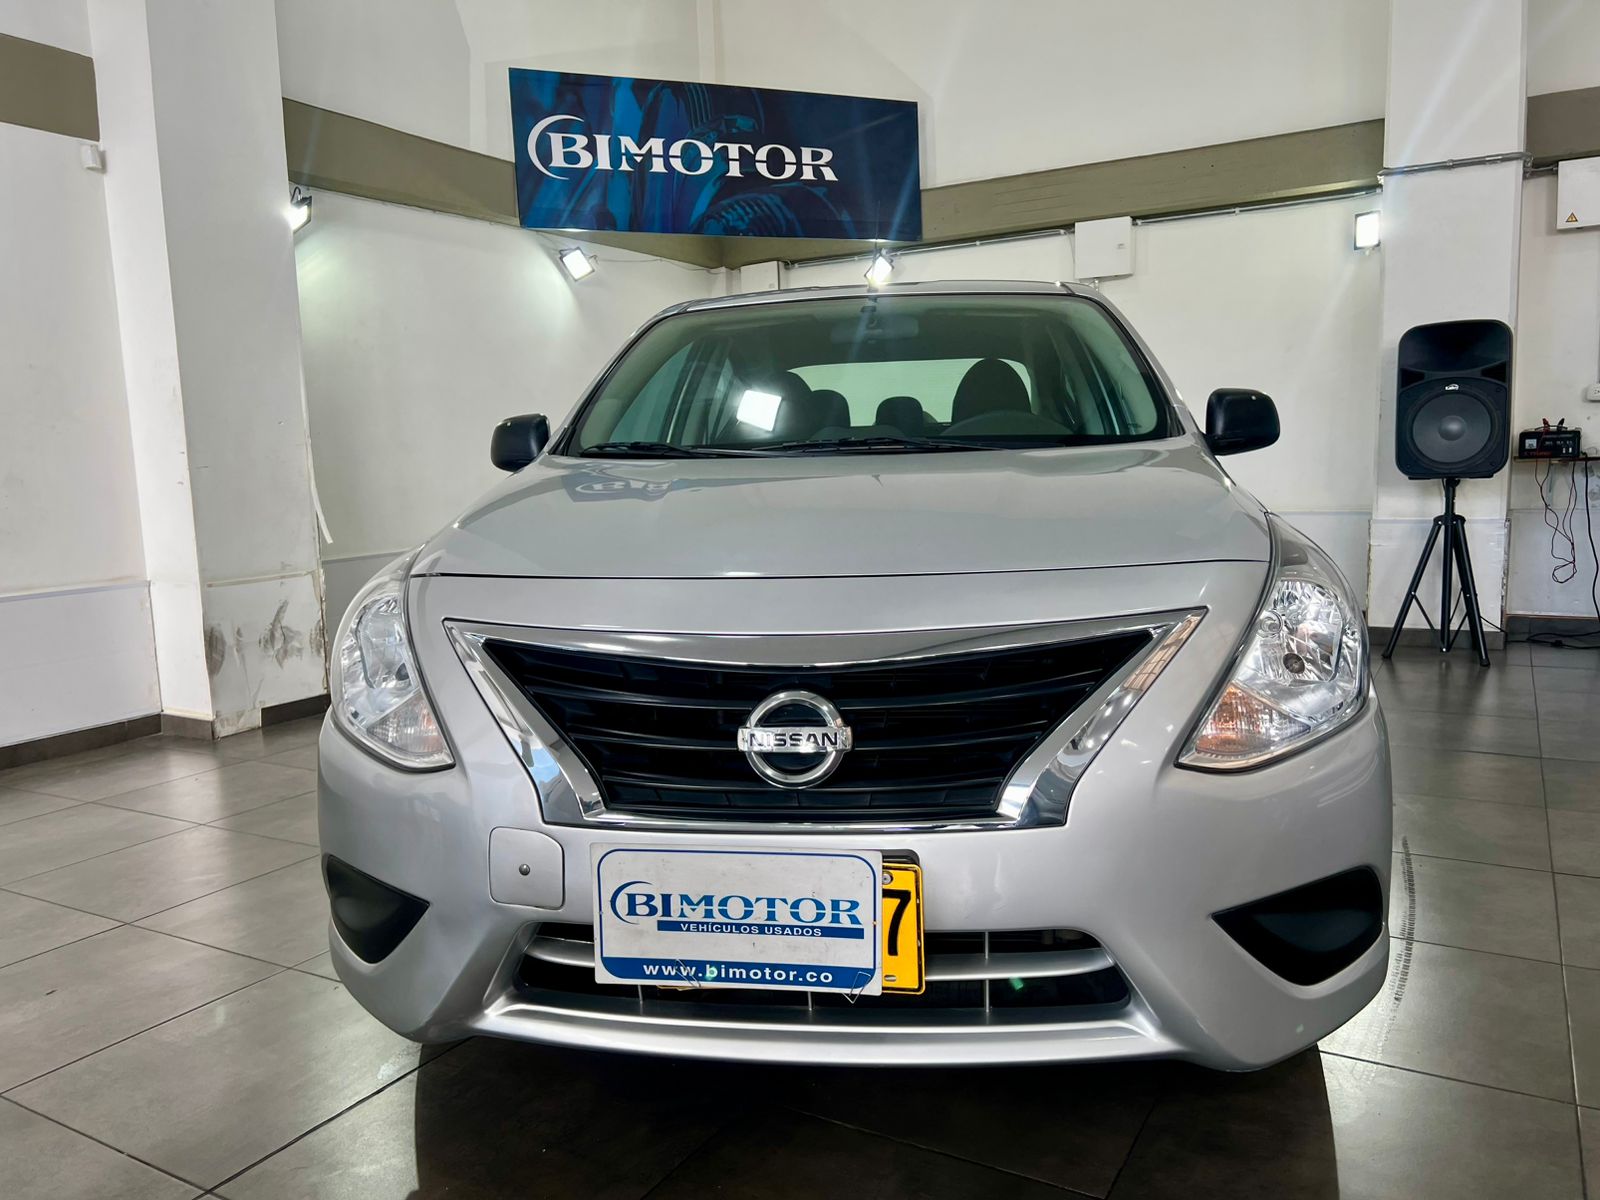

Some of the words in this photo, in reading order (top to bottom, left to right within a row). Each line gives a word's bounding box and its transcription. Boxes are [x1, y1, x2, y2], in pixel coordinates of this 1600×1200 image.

[548, 132, 839, 182] BIMOTOR
[749, 731, 838, 747] NISSAN
[624, 892, 863, 926] BIMOTOR
[680, 921, 760, 935] VEHÍCULOS
[764, 925, 823, 937] USADOS
[643, 963, 834, 984] www.bimotor.co
